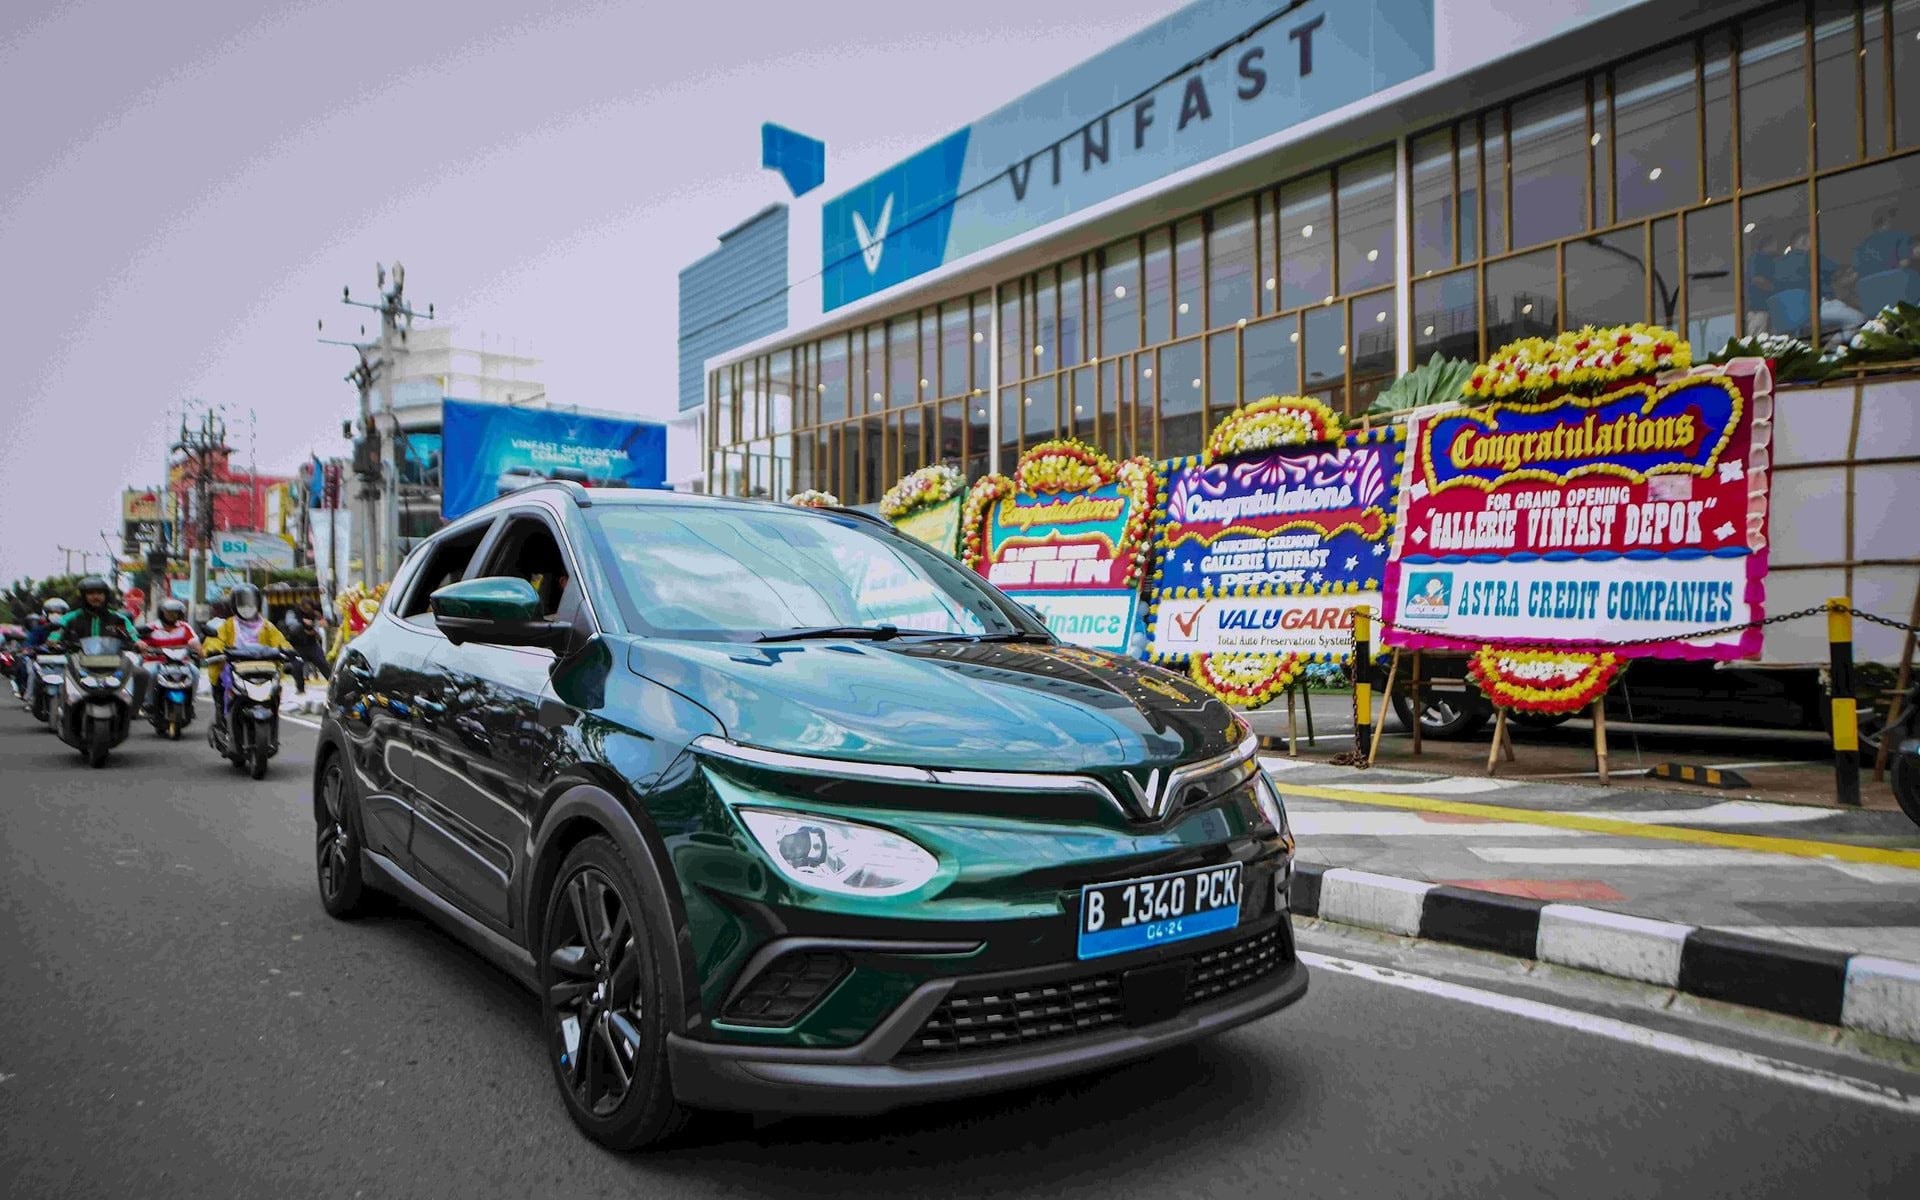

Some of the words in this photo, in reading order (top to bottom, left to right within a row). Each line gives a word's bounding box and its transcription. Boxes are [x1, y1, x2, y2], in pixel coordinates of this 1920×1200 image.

[1006, 12, 1326, 202] VINFAST
[511, 439, 558, 452] VINFAST
[1450, 411, 1695, 470] Congratulations
[531, 449, 576, 463] COMING
[579, 454, 610, 466] SOON
[1186, 485, 1353, 525] Congratulations
[1486, 494, 1511, 511] FOR
[1515, 491, 1560, 509] GRAND
[1566, 486, 1630, 507] OPENING
[1527, 505, 1616, 548] VINFAST
[222, 541, 248, 553] BSI
[1201, 553, 1266, 573] GALLERIE
[1267, 549, 1330, 570] VINFAST
[1221, 570, 1306, 586] DEPOK
[1458, 580, 1520, 617] ASTRA
[1528, 580, 1599, 620] CREDIT
[1607, 580, 1733, 623] COMPANIES
[1218, 635, 1237, 646] Total
[1239, 635, 1258, 646] Auto
[1260, 634, 1316, 646] Preservation
[1087, 891, 1105, 932] B
[1121, 877, 1186, 927] 1340
[1195, 867, 1238, 912] PCK
